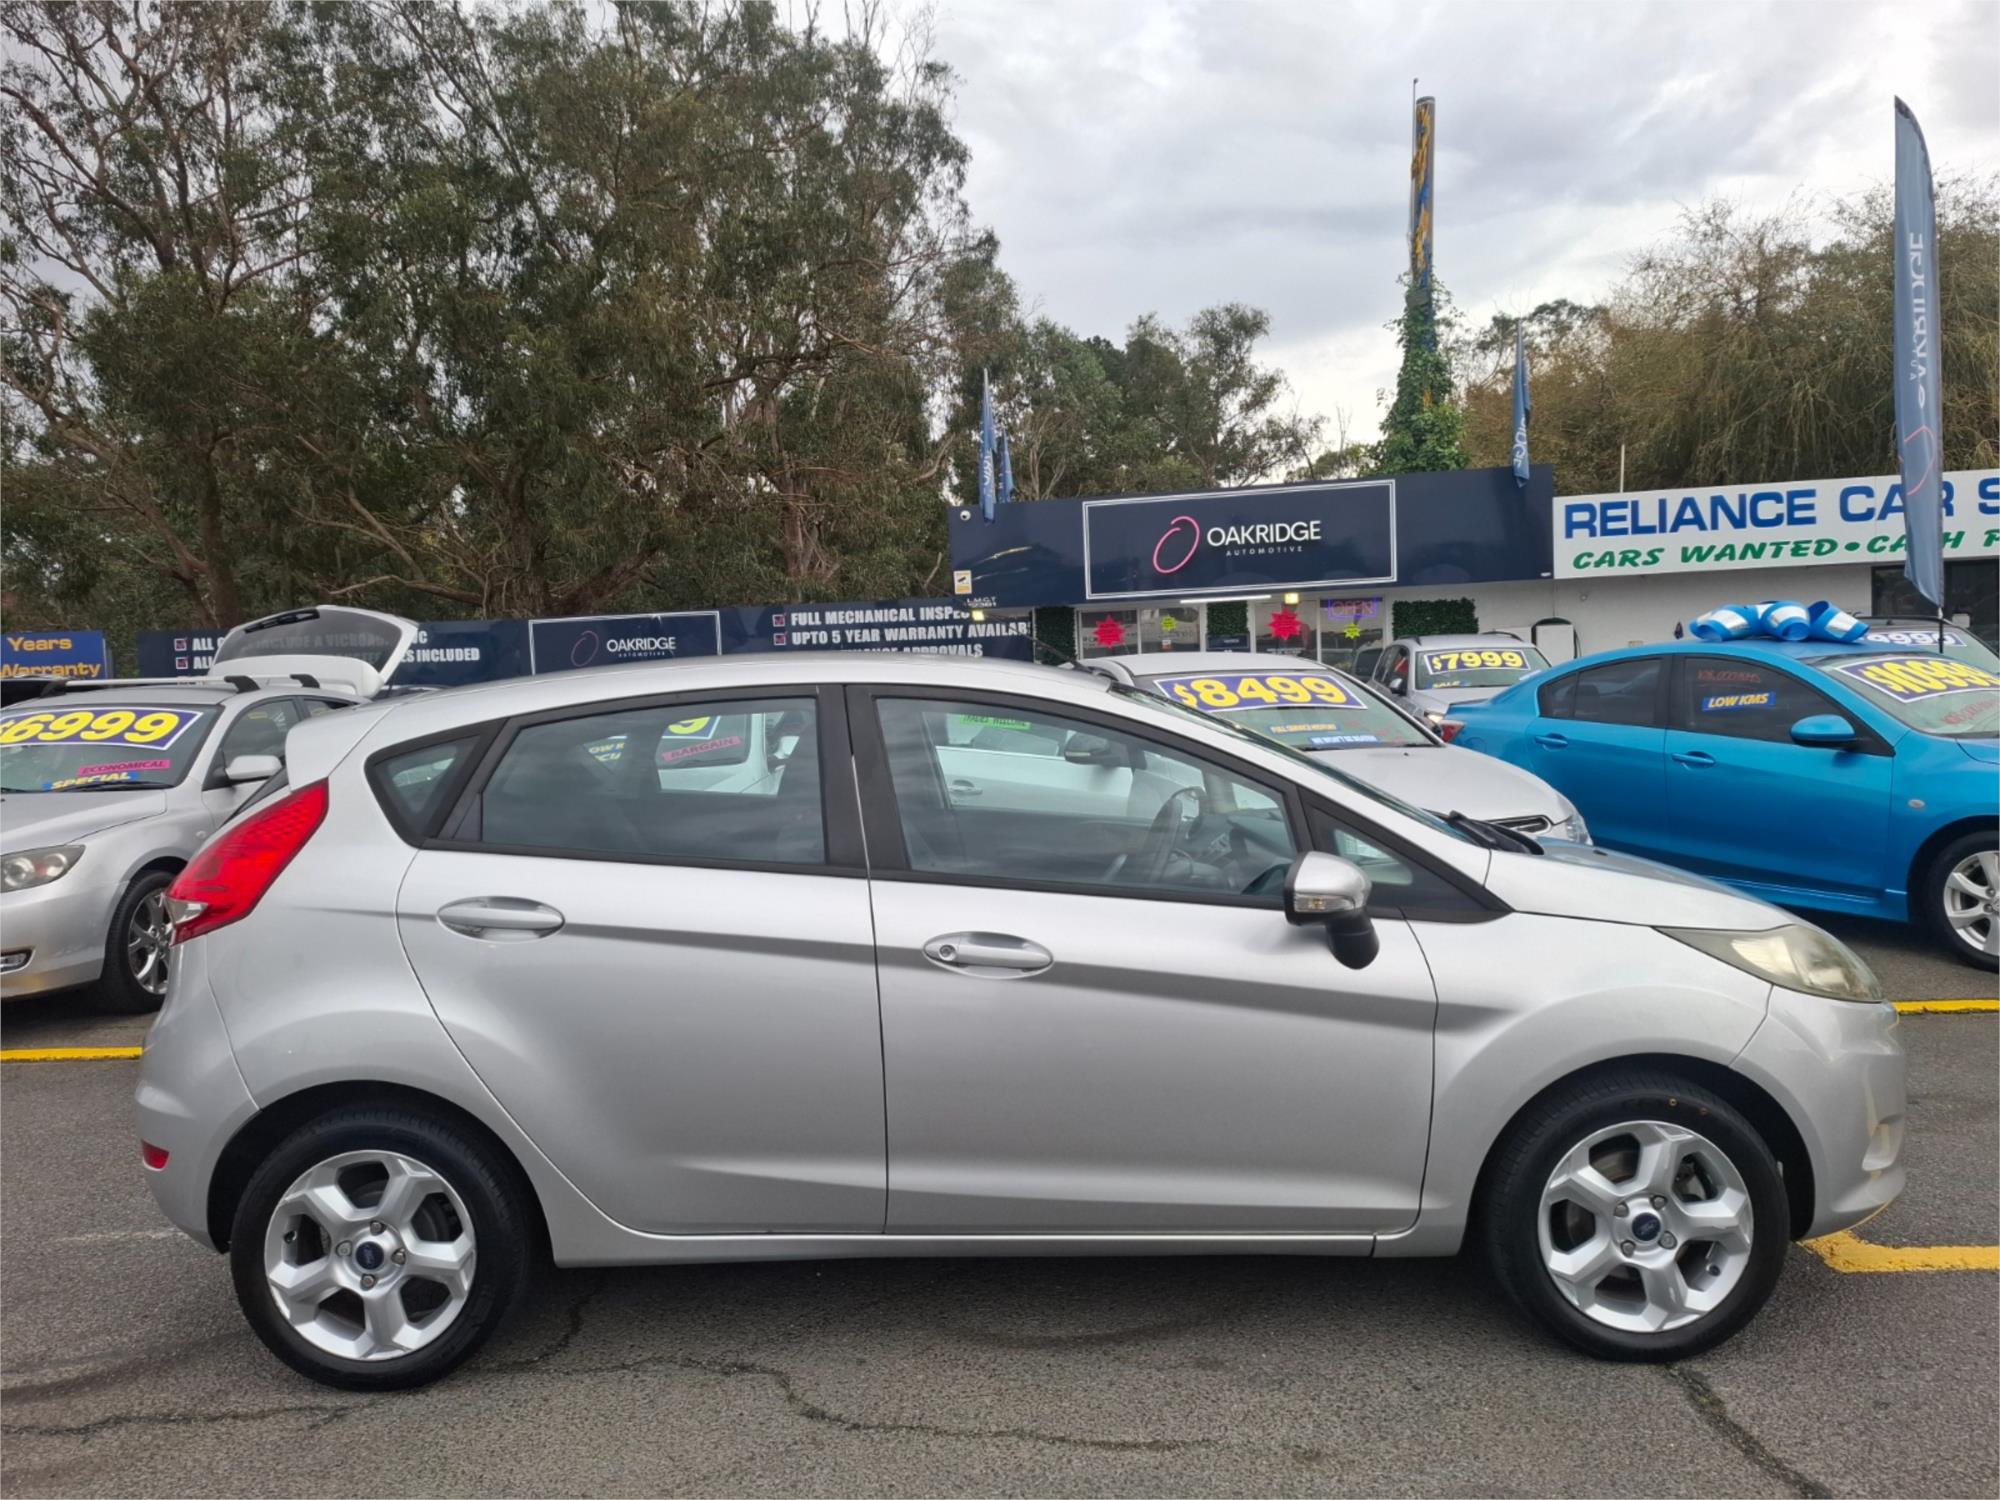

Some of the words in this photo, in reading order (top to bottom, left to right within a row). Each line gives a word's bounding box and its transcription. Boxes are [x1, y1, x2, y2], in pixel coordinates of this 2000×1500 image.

[1564, 489, 1817, 538] RELIANCE
[1206, 520, 1322, 547] OAKRIDGE
[1226, 546, 1303, 556] AUTOMOTIVE
[1572, 547, 1665, 570] CARS
[1681, 538, 1838, 564] WANTED
[1867, 531, 1965, 554] CAH
[791, 612, 822, 626] FULL
[825, 608, 916, 625] MECHANICAL
[792, 631, 828, 645] UPTO
[832, 630, 841, 644] 5
[845, 629, 880, 643] YEAR
[884, 625, 964, 641] WARRANTY
[968, 622, 1031, 638] AVAILAB
[6, 636, 73, 651] Years
[192, 638, 215, 651] ALL
[606, 637, 677, 652] OAKRIDGE
[416, 647, 480, 662] INCLUDED
[1432, 651, 1523, 670] $7999
[0, 662, 101, 678] Warranty
[1173, 676, 1348, 709] $8499
[1708, 696, 1740, 708] LOW
[1739, 693, 1770, 705] KMS
[672, 738, 733, 758] BARGAIN
[82, 760, 164, 774] ECONOMICAL
[51, 772, 132, 789] SPECIAL
